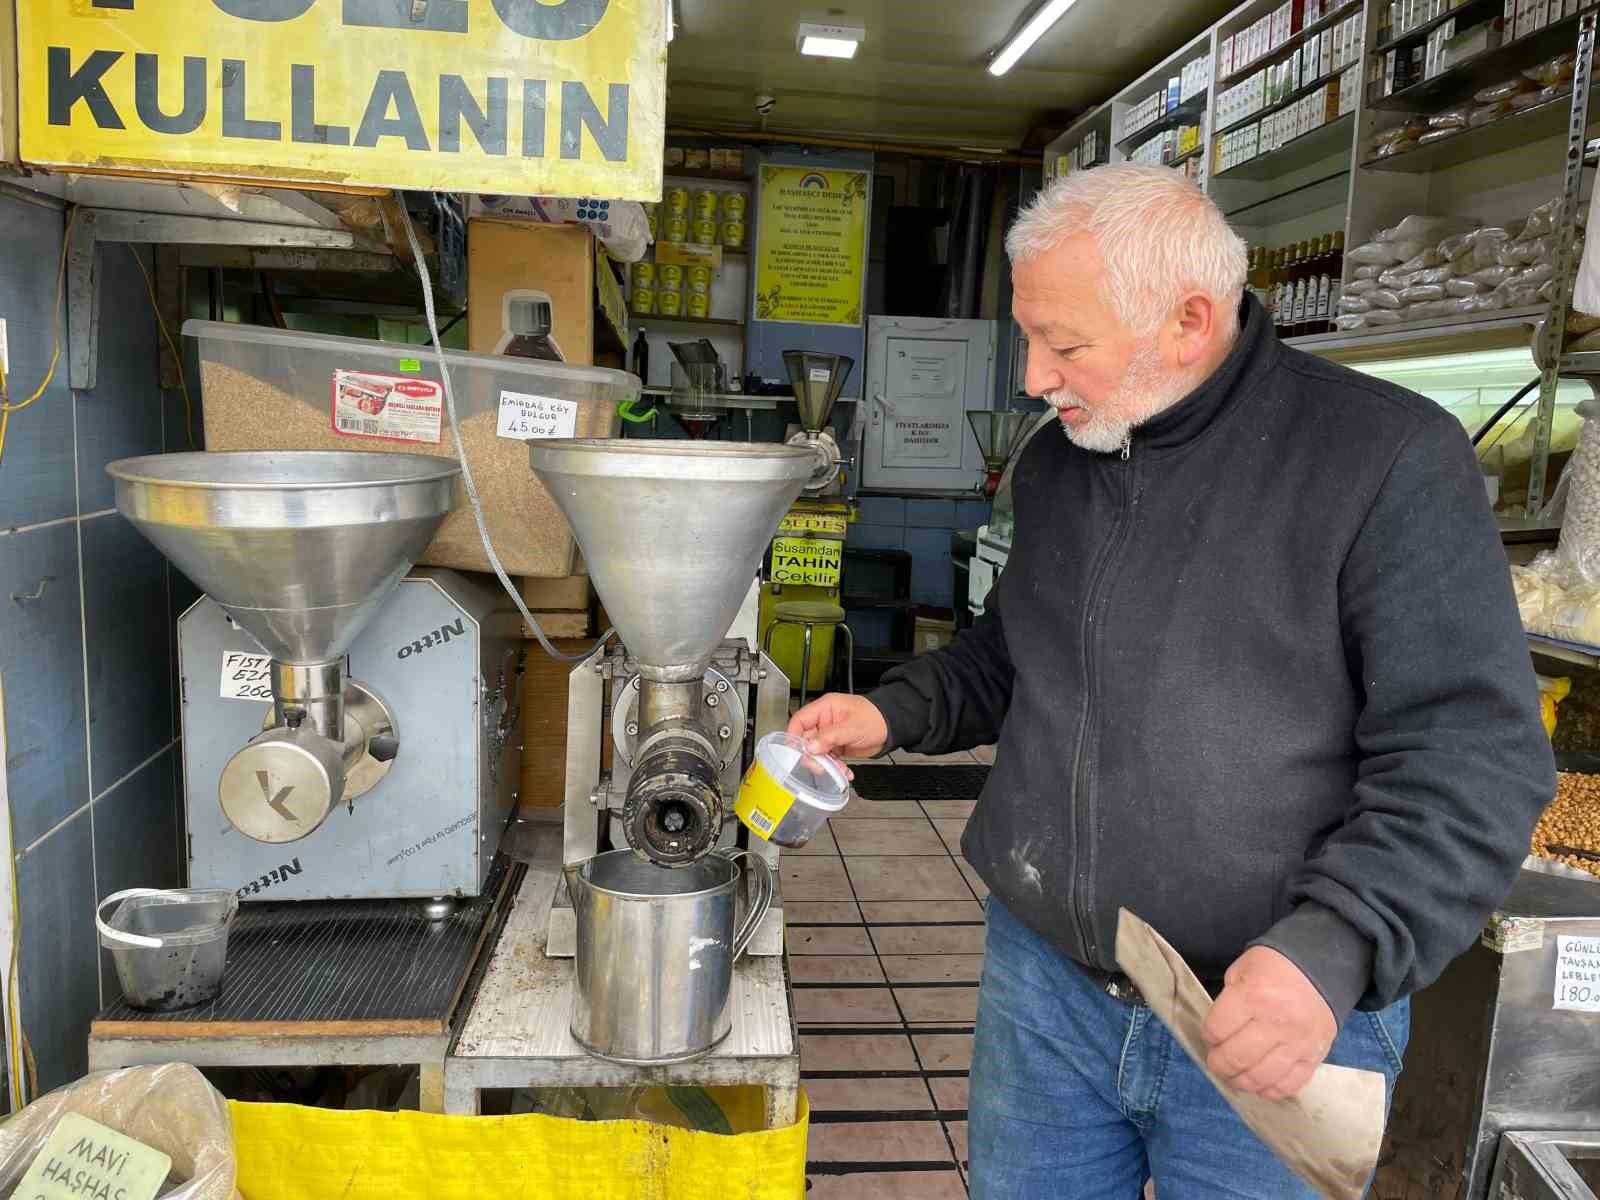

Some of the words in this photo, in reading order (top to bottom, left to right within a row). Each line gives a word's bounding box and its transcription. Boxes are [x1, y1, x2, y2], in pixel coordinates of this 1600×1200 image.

[47, 46, 630, 162] KULLANIN
[775, 541, 841, 557] Susamdan
[398, 618, 465, 659] Nitto
[67, 1136, 130, 1176] MAVİ
